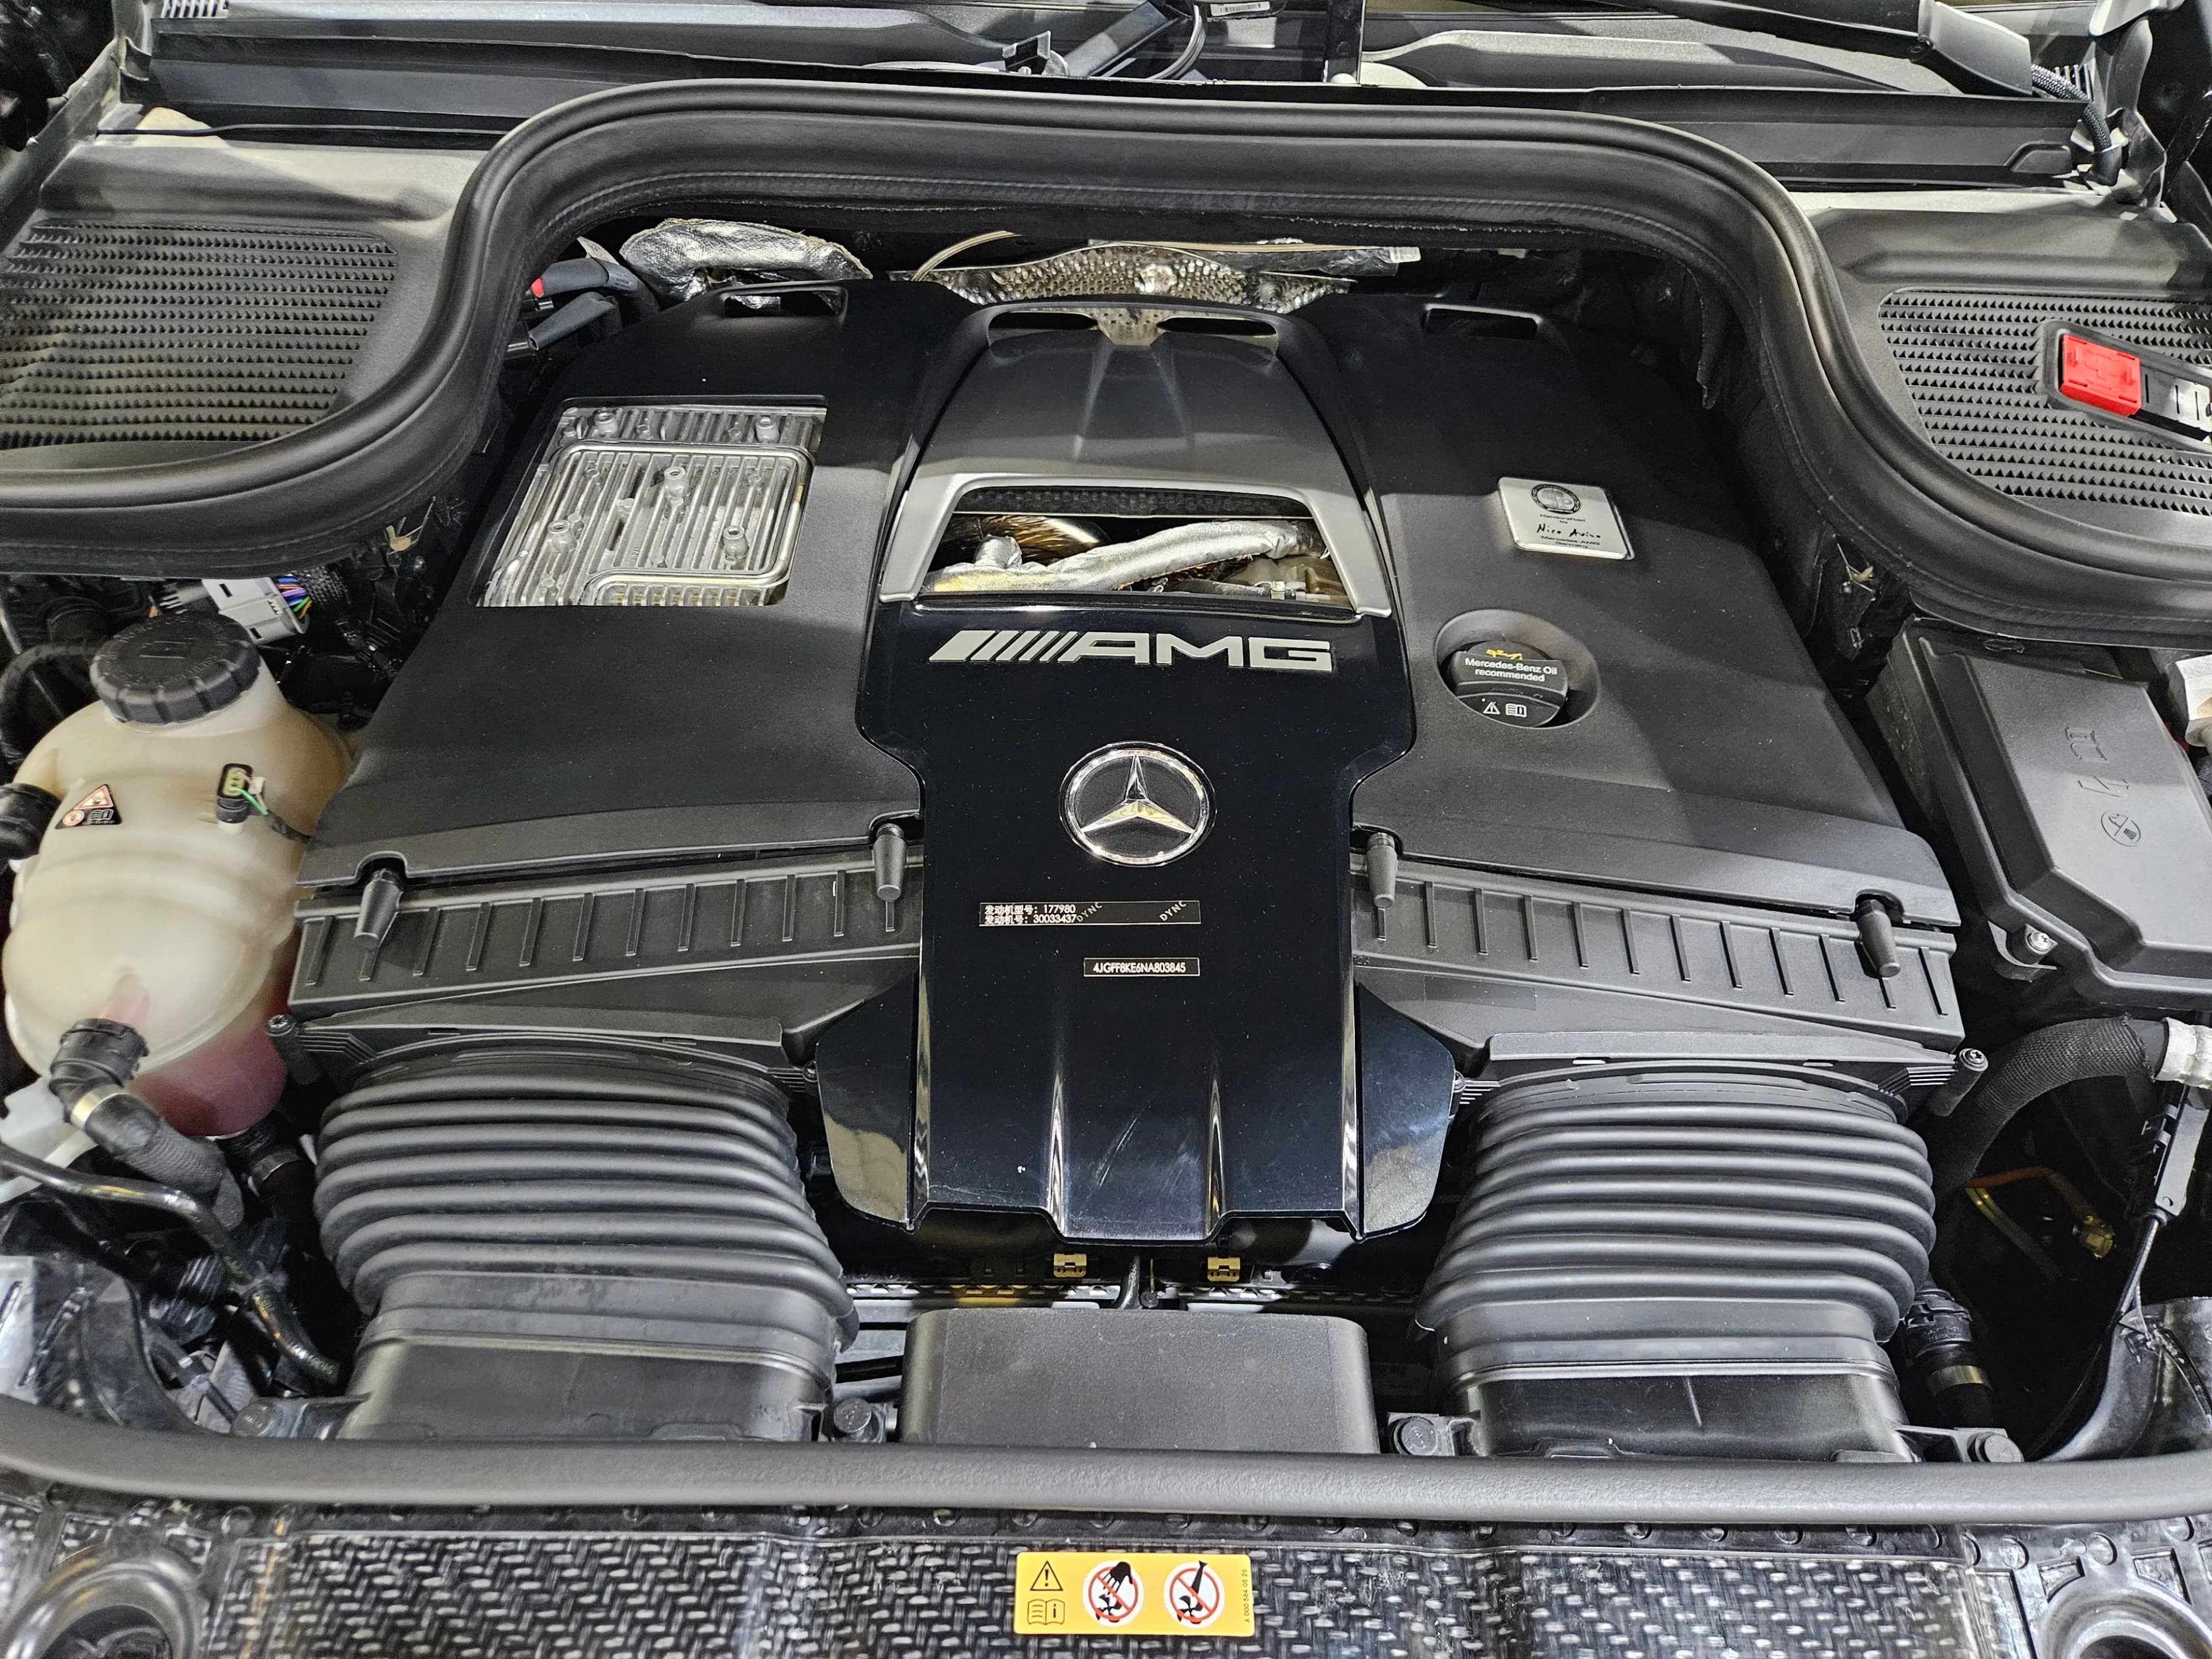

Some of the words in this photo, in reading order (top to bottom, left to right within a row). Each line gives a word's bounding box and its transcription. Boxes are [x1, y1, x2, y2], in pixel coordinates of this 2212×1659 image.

[1465, 658, 1541, 673] Mercedes-Benz
[1543, 666, 1558, 675] Oil
[1475, 669, 1546, 682] recommended
[1043, 904, 1076, 914] 177980
